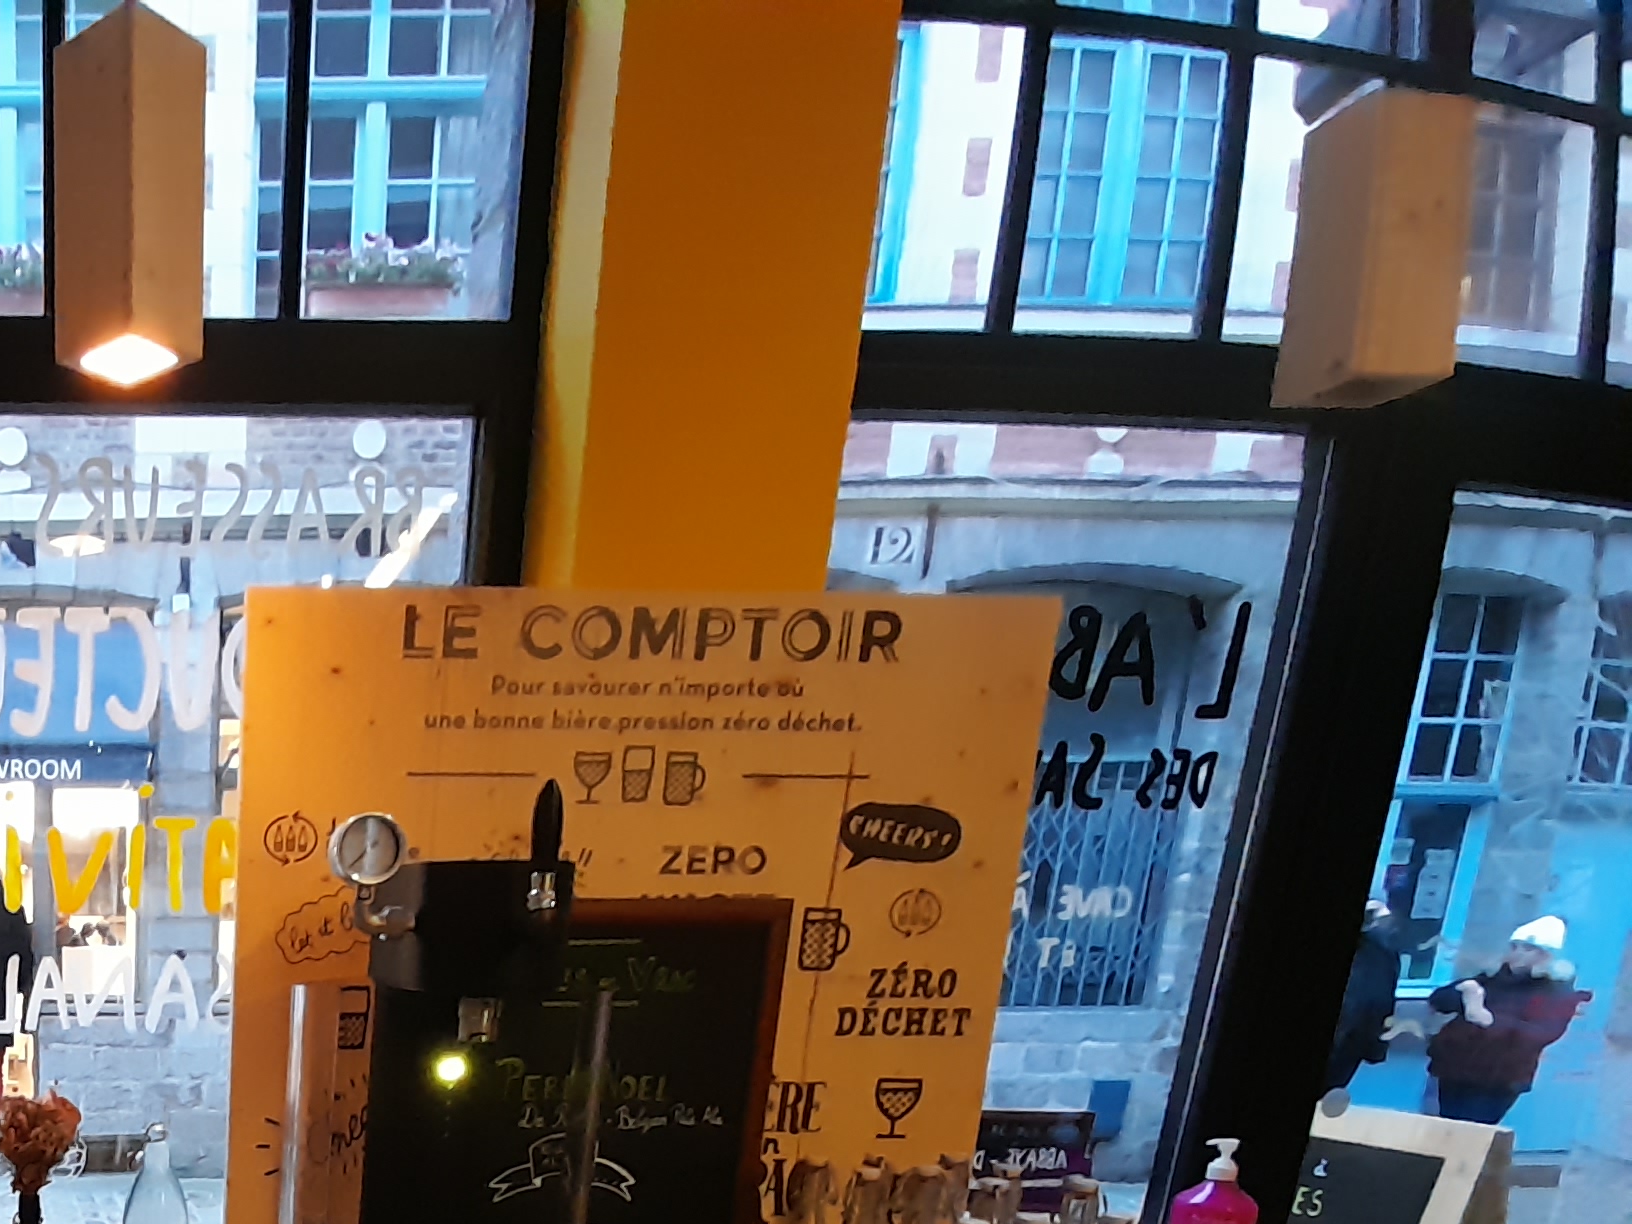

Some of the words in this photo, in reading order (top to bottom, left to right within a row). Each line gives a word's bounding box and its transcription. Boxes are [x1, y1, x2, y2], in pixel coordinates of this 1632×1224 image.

[870, 524, 915, 564] 12
[402, 605, 483, 660] LE
[520, 604, 904, 663] COMPTOIR
[491, 675, 545, 697] Pour
[552, 680, 651, 697] savourer
[658, 677, 769, 703] n'importe
[776, 677, 805, 698] où
[424, 714, 466, 731] une
[473, 712, 545, 731] bonne
[552, 711, 610, 731] bière
[617, 712, 715, 735] pression
[722, 711, 770, 732] zéro
[659, 845, 768, 876] ZERO
[865, 961, 958, 999] ZÉRO
[834, 1001, 972, 1037] DÉCHET
